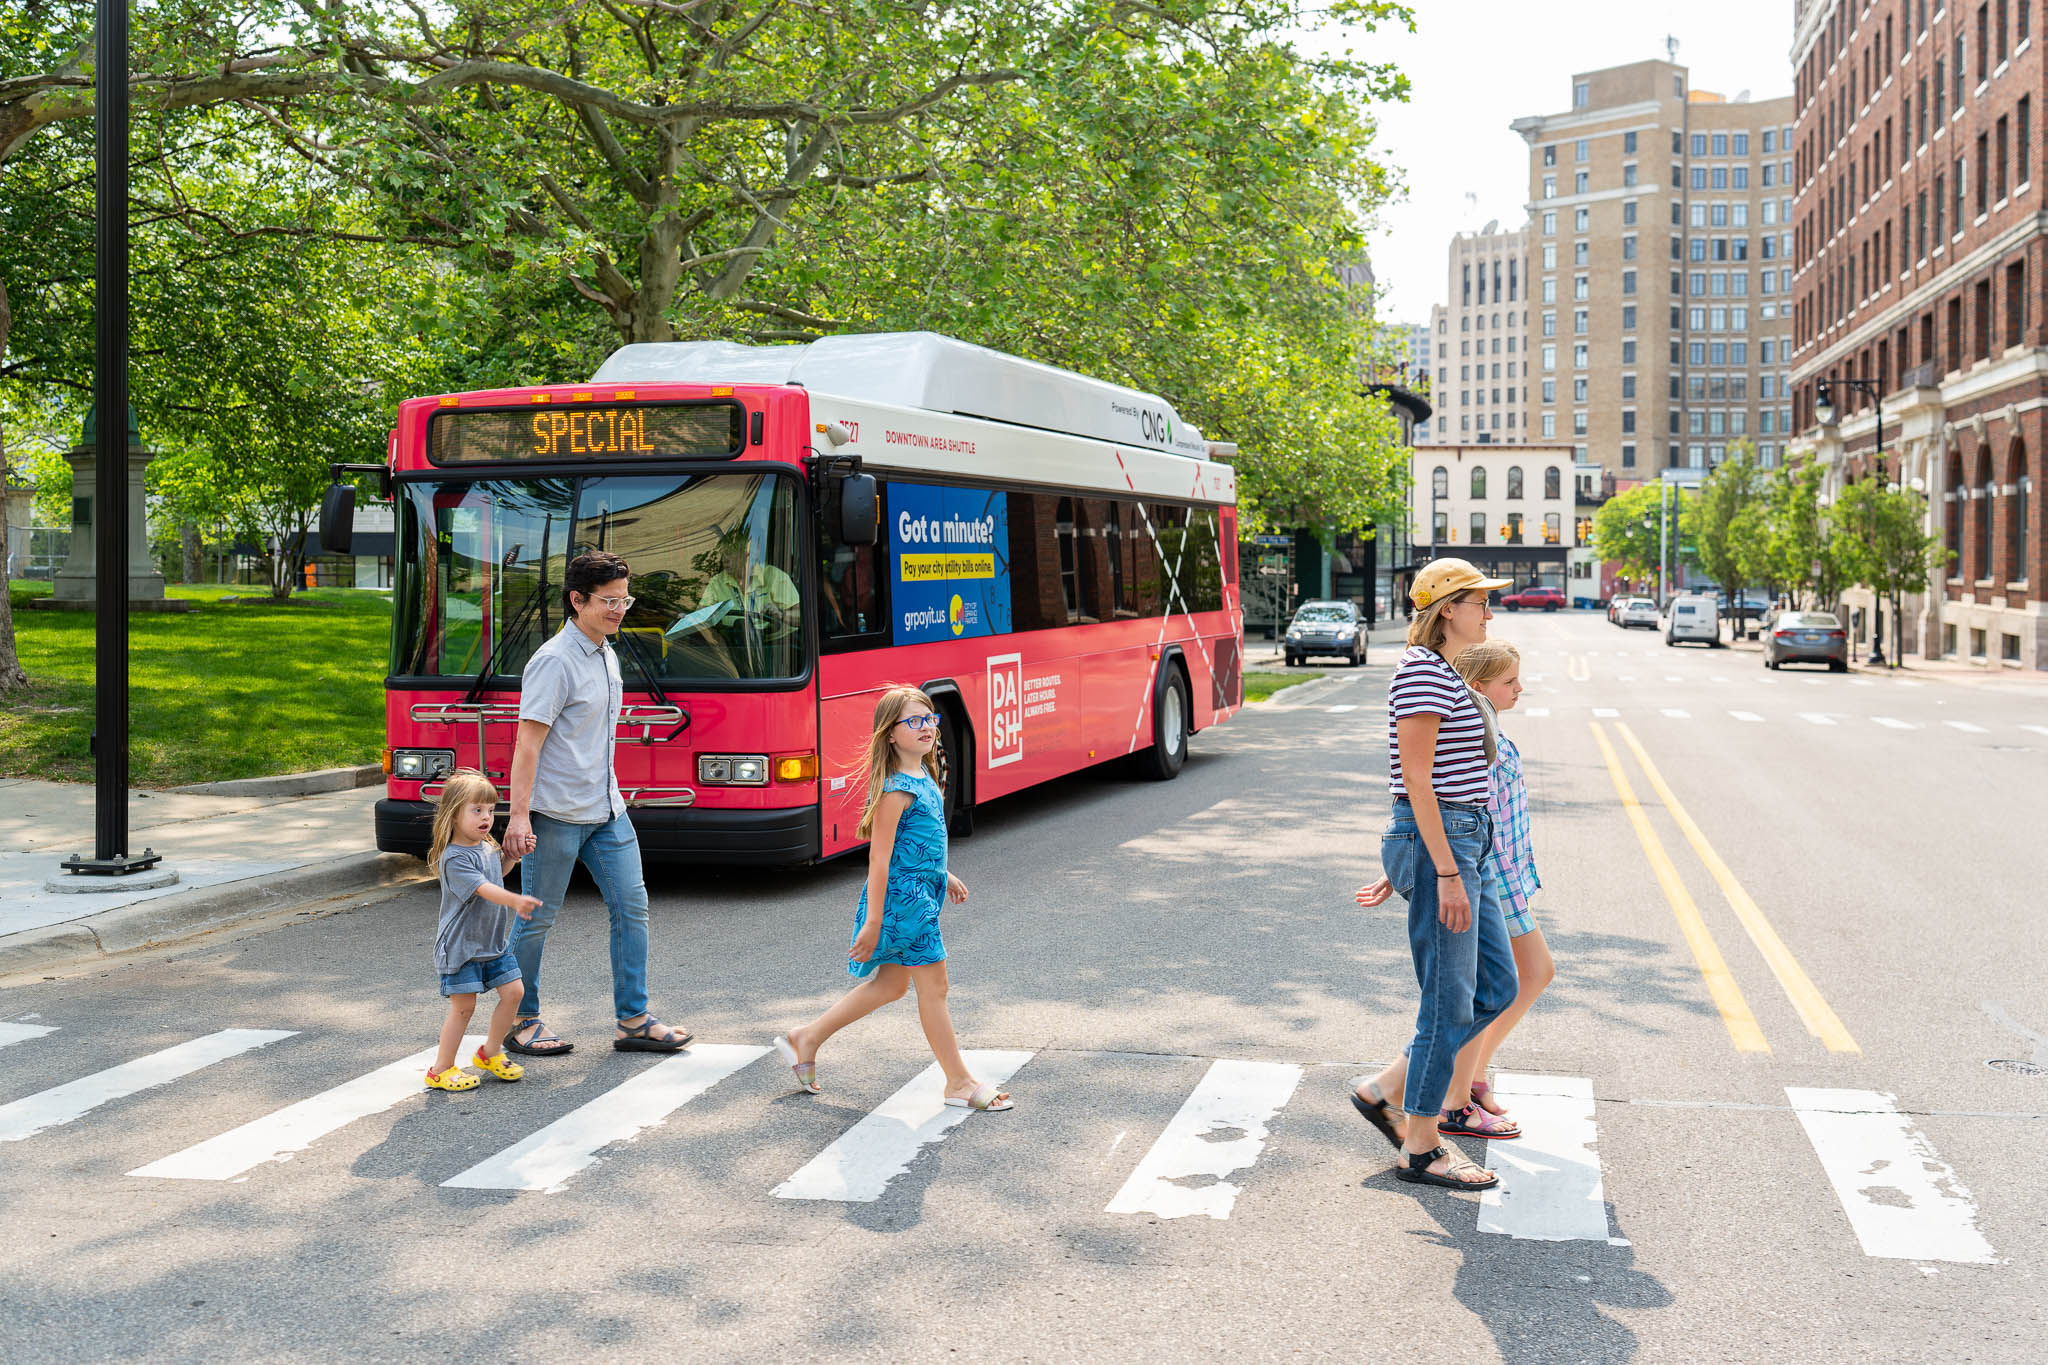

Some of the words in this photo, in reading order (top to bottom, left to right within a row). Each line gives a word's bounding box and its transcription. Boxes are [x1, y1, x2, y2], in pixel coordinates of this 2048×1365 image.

[532, 410, 655, 454] SPECIAL
[1142, 409, 1165, 443] CNG
[886, 430, 929, 448] DOWNTOWN
[930, 437, 947, 451] AREA
[949, 439, 976, 454] SHUTTLE
[899, 511, 928, 543] Got
[930, 520, 940, 543] a
[943, 512, 994, 544] minute?
[904, 561, 916, 577] Pay
[918, 563, 931, 577] your
[932, 560, 944, 576] city
[944, 560, 961, 576] utility
[962, 560, 974, 573] bills
[974, 560, 992, 573] online.
[904, 606, 946, 631] grpayit.us
[993, 671, 1017, 710] DA
[1024, 678, 1041, 691] BETTER
[1024, 692, 1039, 704] LATER
[1024, 704, 1043, 718] ALWAYS
[993, 710, 1018, 750] SH
